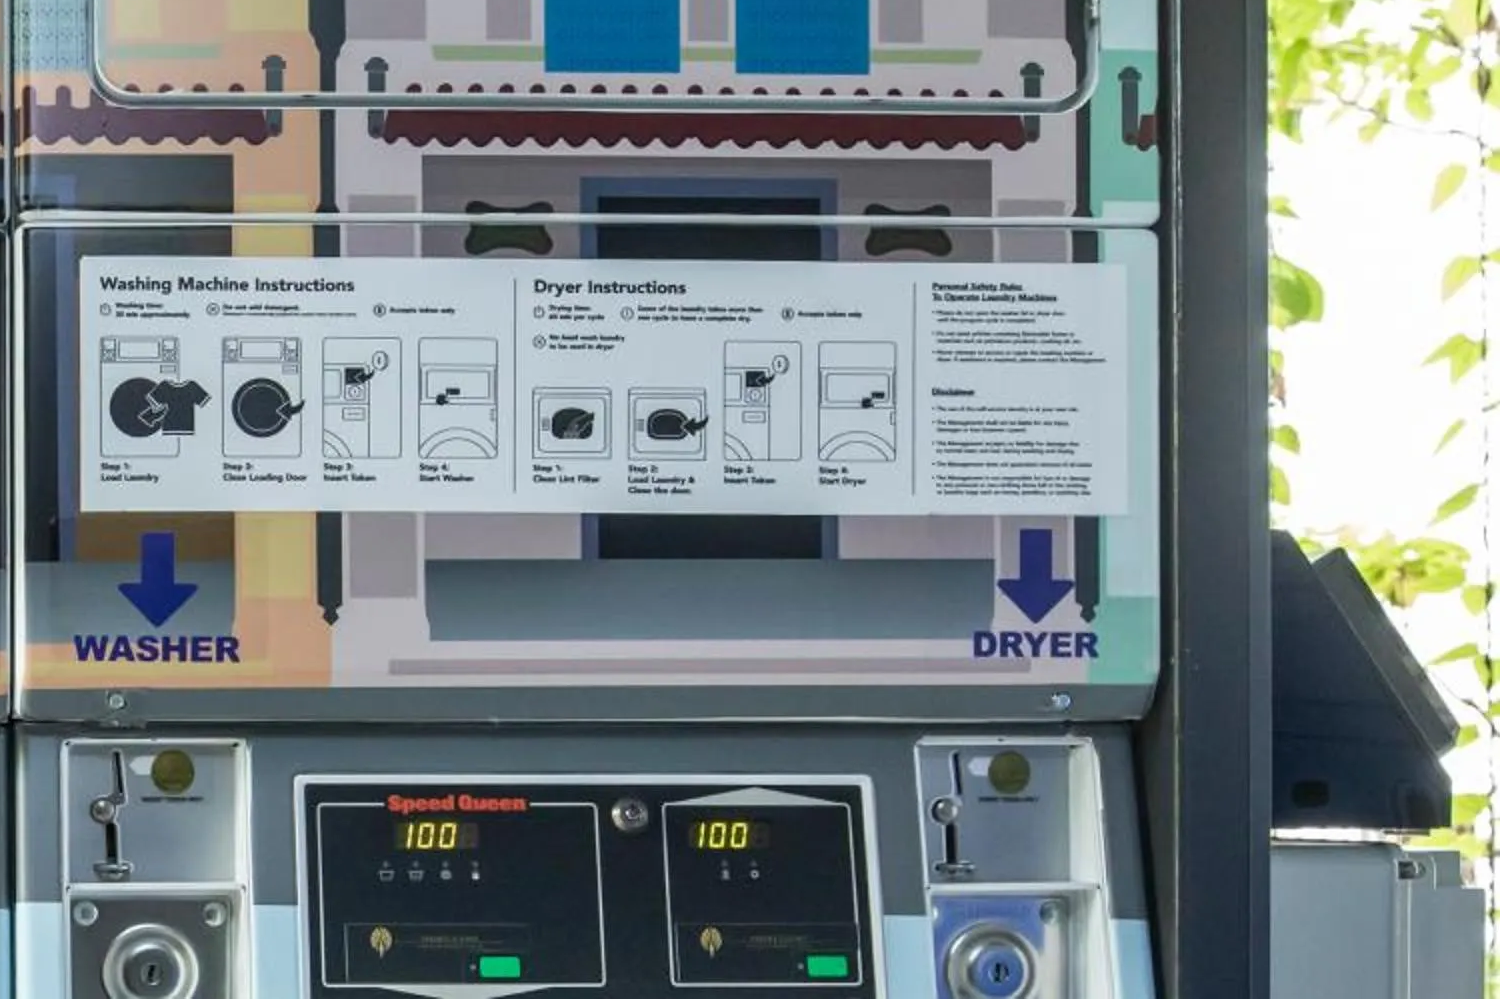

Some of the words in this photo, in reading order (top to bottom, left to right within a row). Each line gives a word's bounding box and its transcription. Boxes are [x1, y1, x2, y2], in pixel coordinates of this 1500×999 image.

[99, 276, 171, 295] Washing
[178, 276, 248, 292] Machine
[255, 277, 355, 292] Instructions
[533, 280, 582, 297] Dryer
[588, 281, 687, 295] Instructions
[74, 634, 240, 663] WASHER
[973, 631, 1099, 658] DRYER
[388, 795, 455, 814] Speed
[458, 795, 526, 811] Queen
[406, 822, 457, 849] 100
[698, 822, 747, 848] 100
